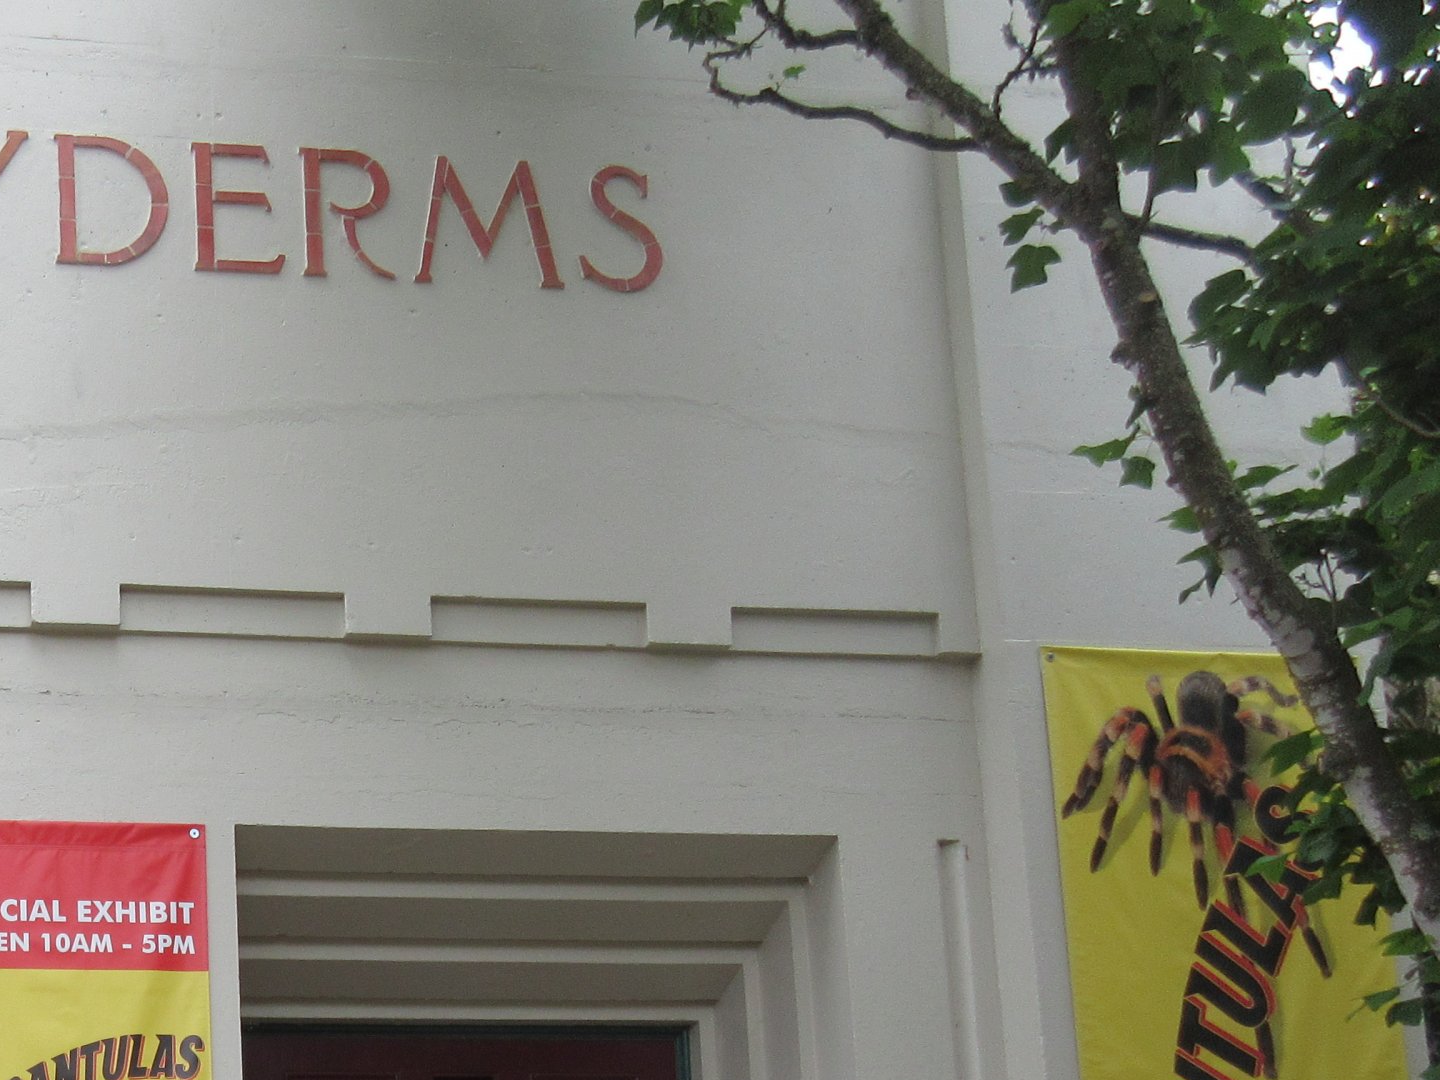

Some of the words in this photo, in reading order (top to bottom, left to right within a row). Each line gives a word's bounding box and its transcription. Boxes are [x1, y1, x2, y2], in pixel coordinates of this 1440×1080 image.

[77, 900, 195, 925] EXHIBIT
[41, 933, 113, 953] 10AM
[142, 934, 196, 955] 5PM
